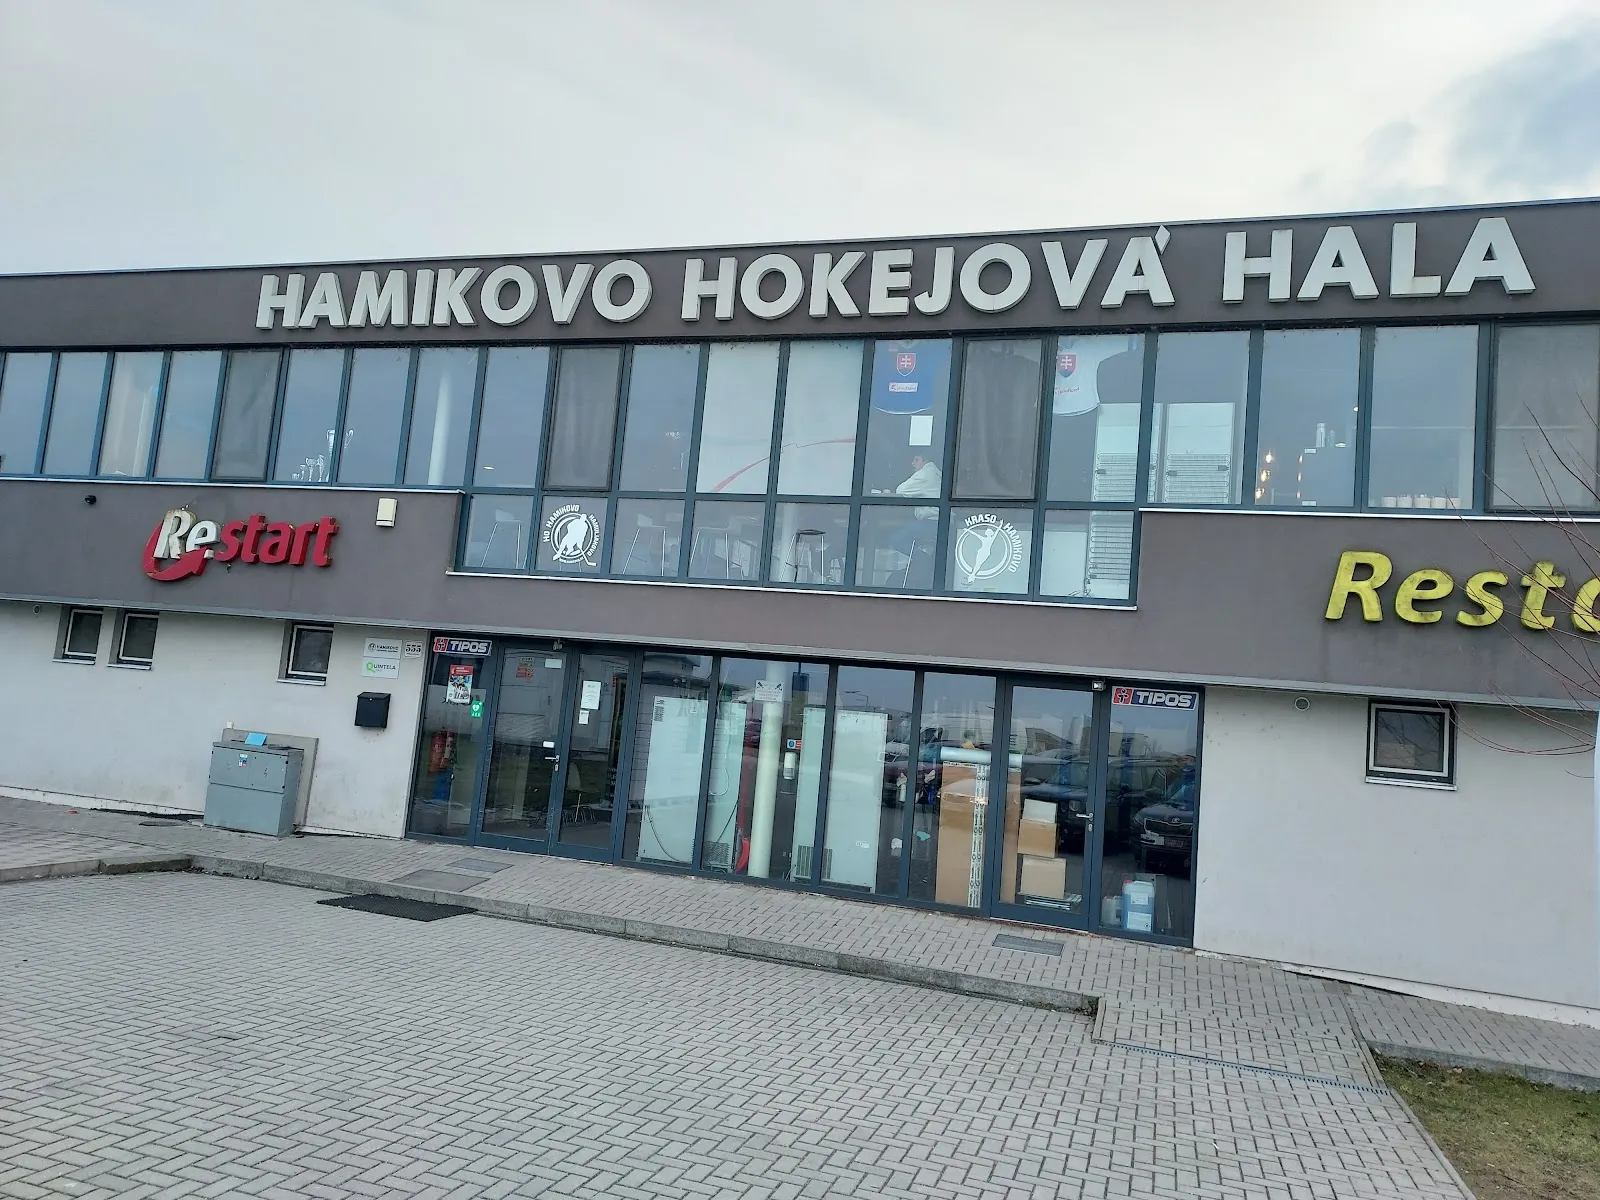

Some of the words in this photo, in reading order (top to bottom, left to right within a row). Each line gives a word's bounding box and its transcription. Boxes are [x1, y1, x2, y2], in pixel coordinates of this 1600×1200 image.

[256, 259, 652, 329] HAMIKOVO
[681, 225, 1176, 321] HOKEJOVÁ
[1222, 217, 1536, 304] HALA
[546, 504, 580, 528] HAMIKOVO
[153, 509, 339, 567] Restart
[964, 513, 997, 527] KRASO
[1003, 522, 1023, 573] HAMIKOVO
[405, 644, 421, 653] 555
[451, 641, 487, 652] TIPOS
[1137, 691, 1192, 708] TIPOS
